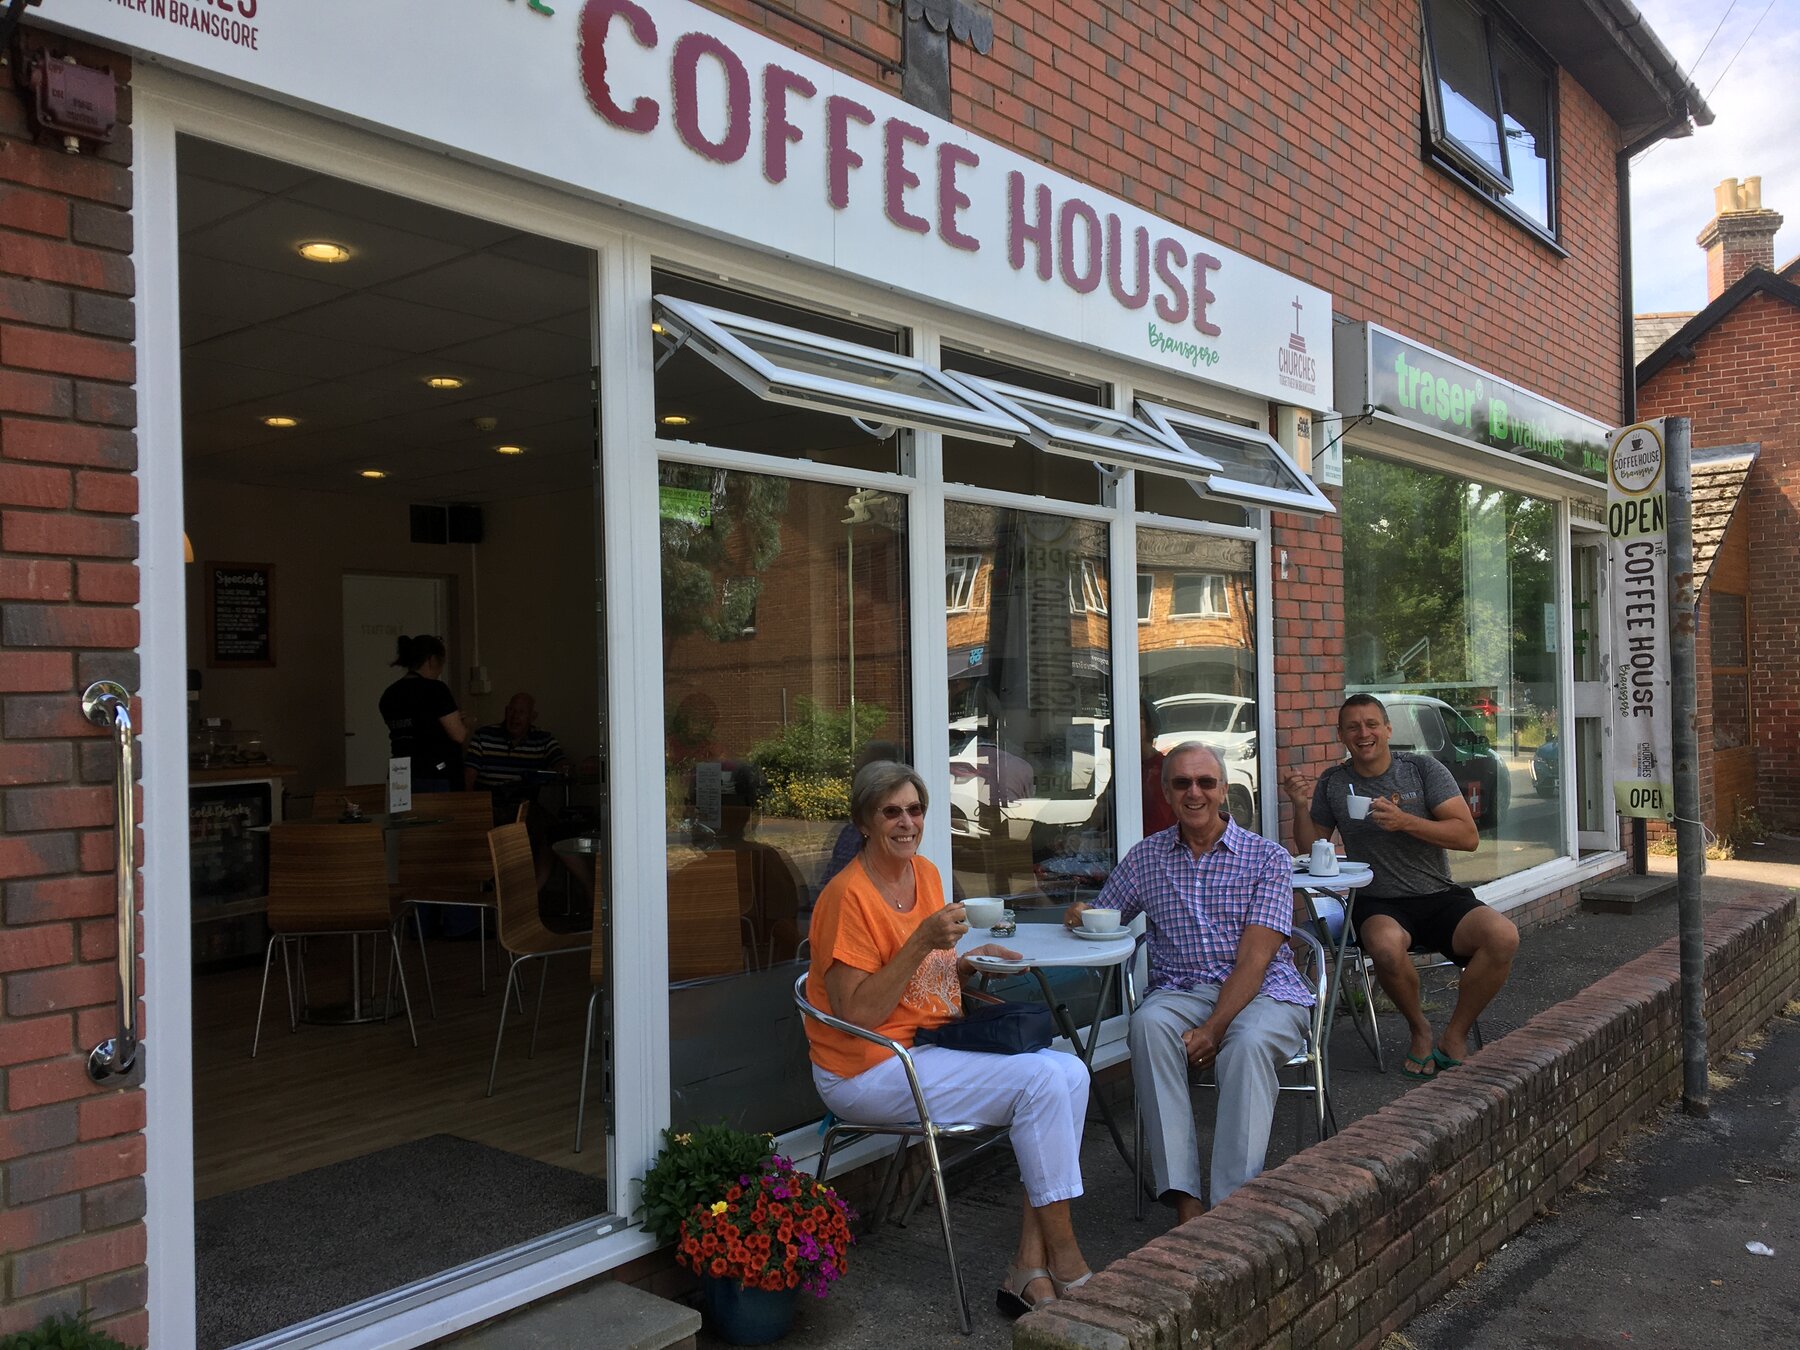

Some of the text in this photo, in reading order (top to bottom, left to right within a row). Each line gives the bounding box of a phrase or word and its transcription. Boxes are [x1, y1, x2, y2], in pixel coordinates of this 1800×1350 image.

[169, 1, 259, 51] BRANSGORE
[577, 0, 1222, 338] COFFEE HOUSE
[1148, 321, 1220, 368] Bransgore
[1278, 347, 1316, 382] CHURCHES
[1511, 415, 1566, 461] watches
[1614, 455, 1638, 471] COFFEE
[1638, 449, 1660, 467] HOUSE
[1608, 494, 1665, 538] OPEN
[215, 570, 265, 588] Specials
[1624, 541, 1656, 718] COFFEE HOUSE
[1641, 742, 1652, 778] CHURCHES
